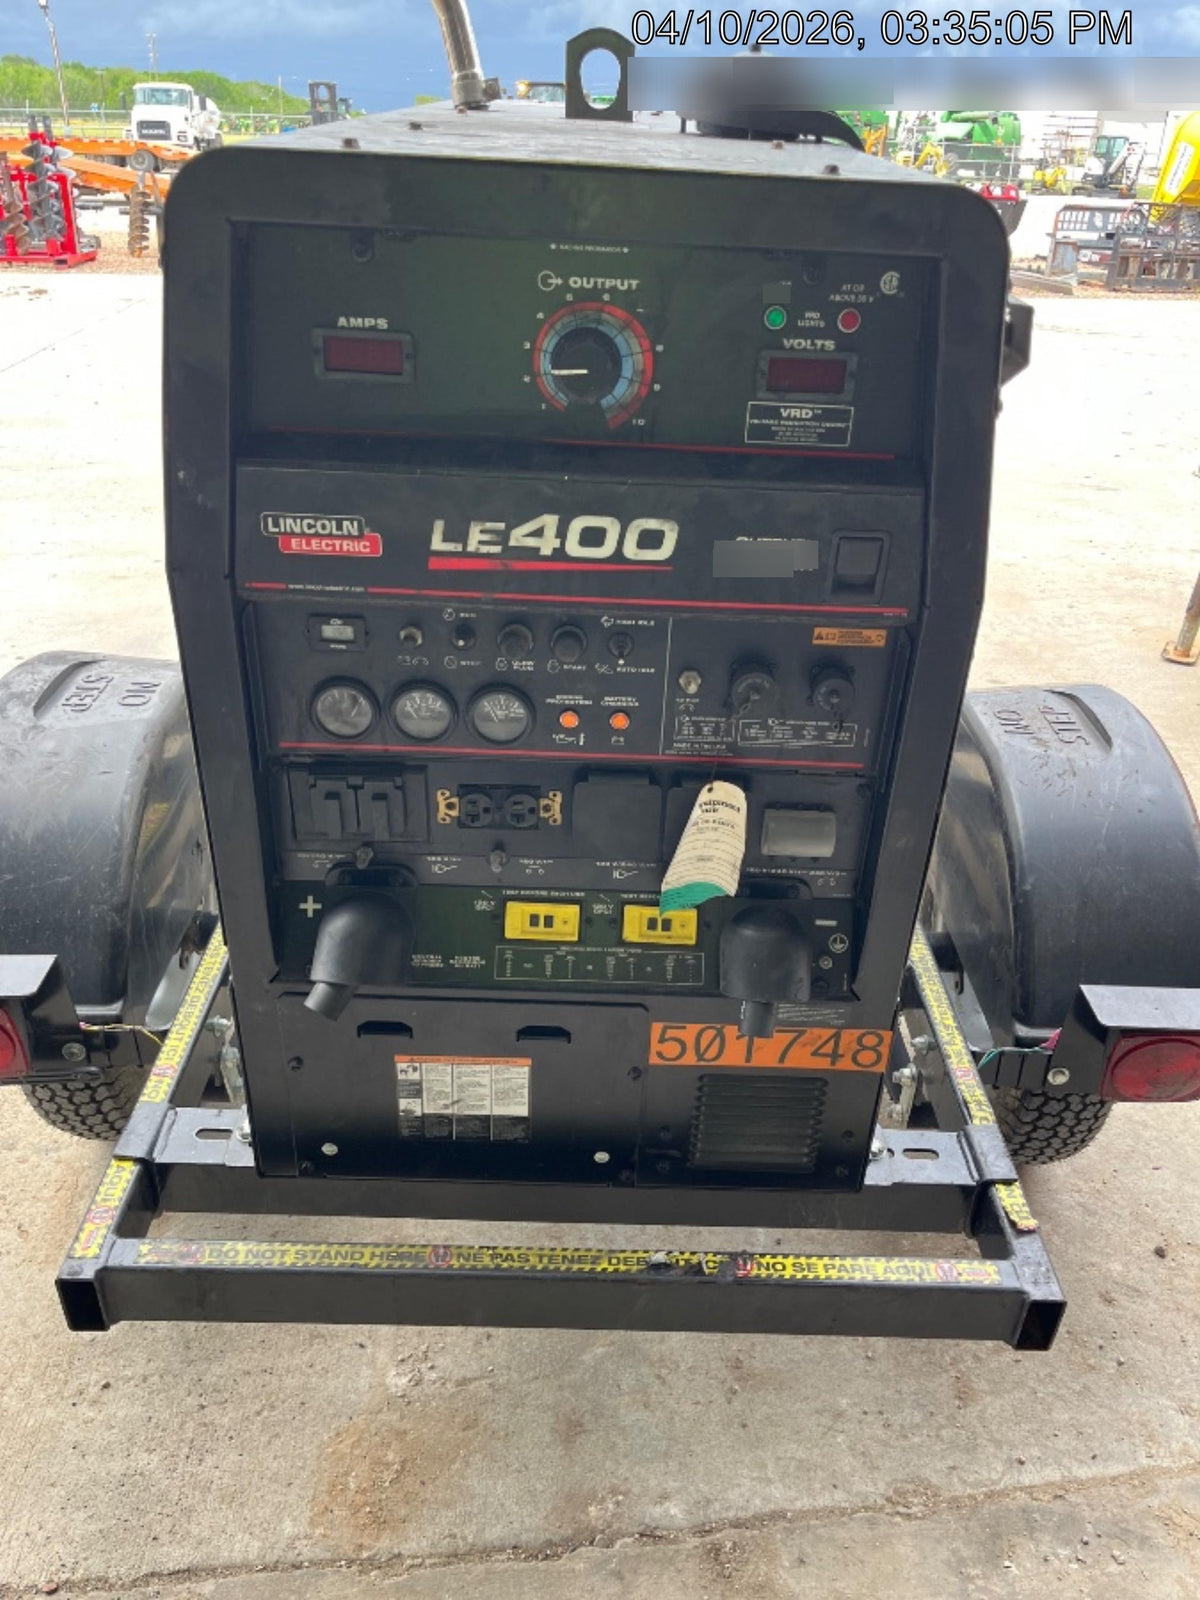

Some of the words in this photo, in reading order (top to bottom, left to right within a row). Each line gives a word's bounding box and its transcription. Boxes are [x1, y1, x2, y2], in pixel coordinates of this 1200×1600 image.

[569, 276, 640, 290] OUTPUT
[337, 316, 389, 329] AMPS
[783, 338, 836, 350] VOLTS
[267, 517, 359, 535] LINCOLN
[430, 513, 679, 560] LE400
[291, 538, 371, 552] ELECTRIC
[655, 1024, 885, 1068] 501748
[206, 1250, 239, 1260] DO
[245, 1250, 288, 1261] NOT
[294, 1250, 363, 1262] STAND
[369, 1251, 425, 1263] HERE
[456, 1253, 484, 1264] NE
[489, 1253, 530, 1264] PAS
[537, 1254, 599, 1266] TENEZ
[757, 1261, 786, 1272] NO
[792, 1262, 818, 1273] SE
[823, 1263, 876, 1275] PARE
